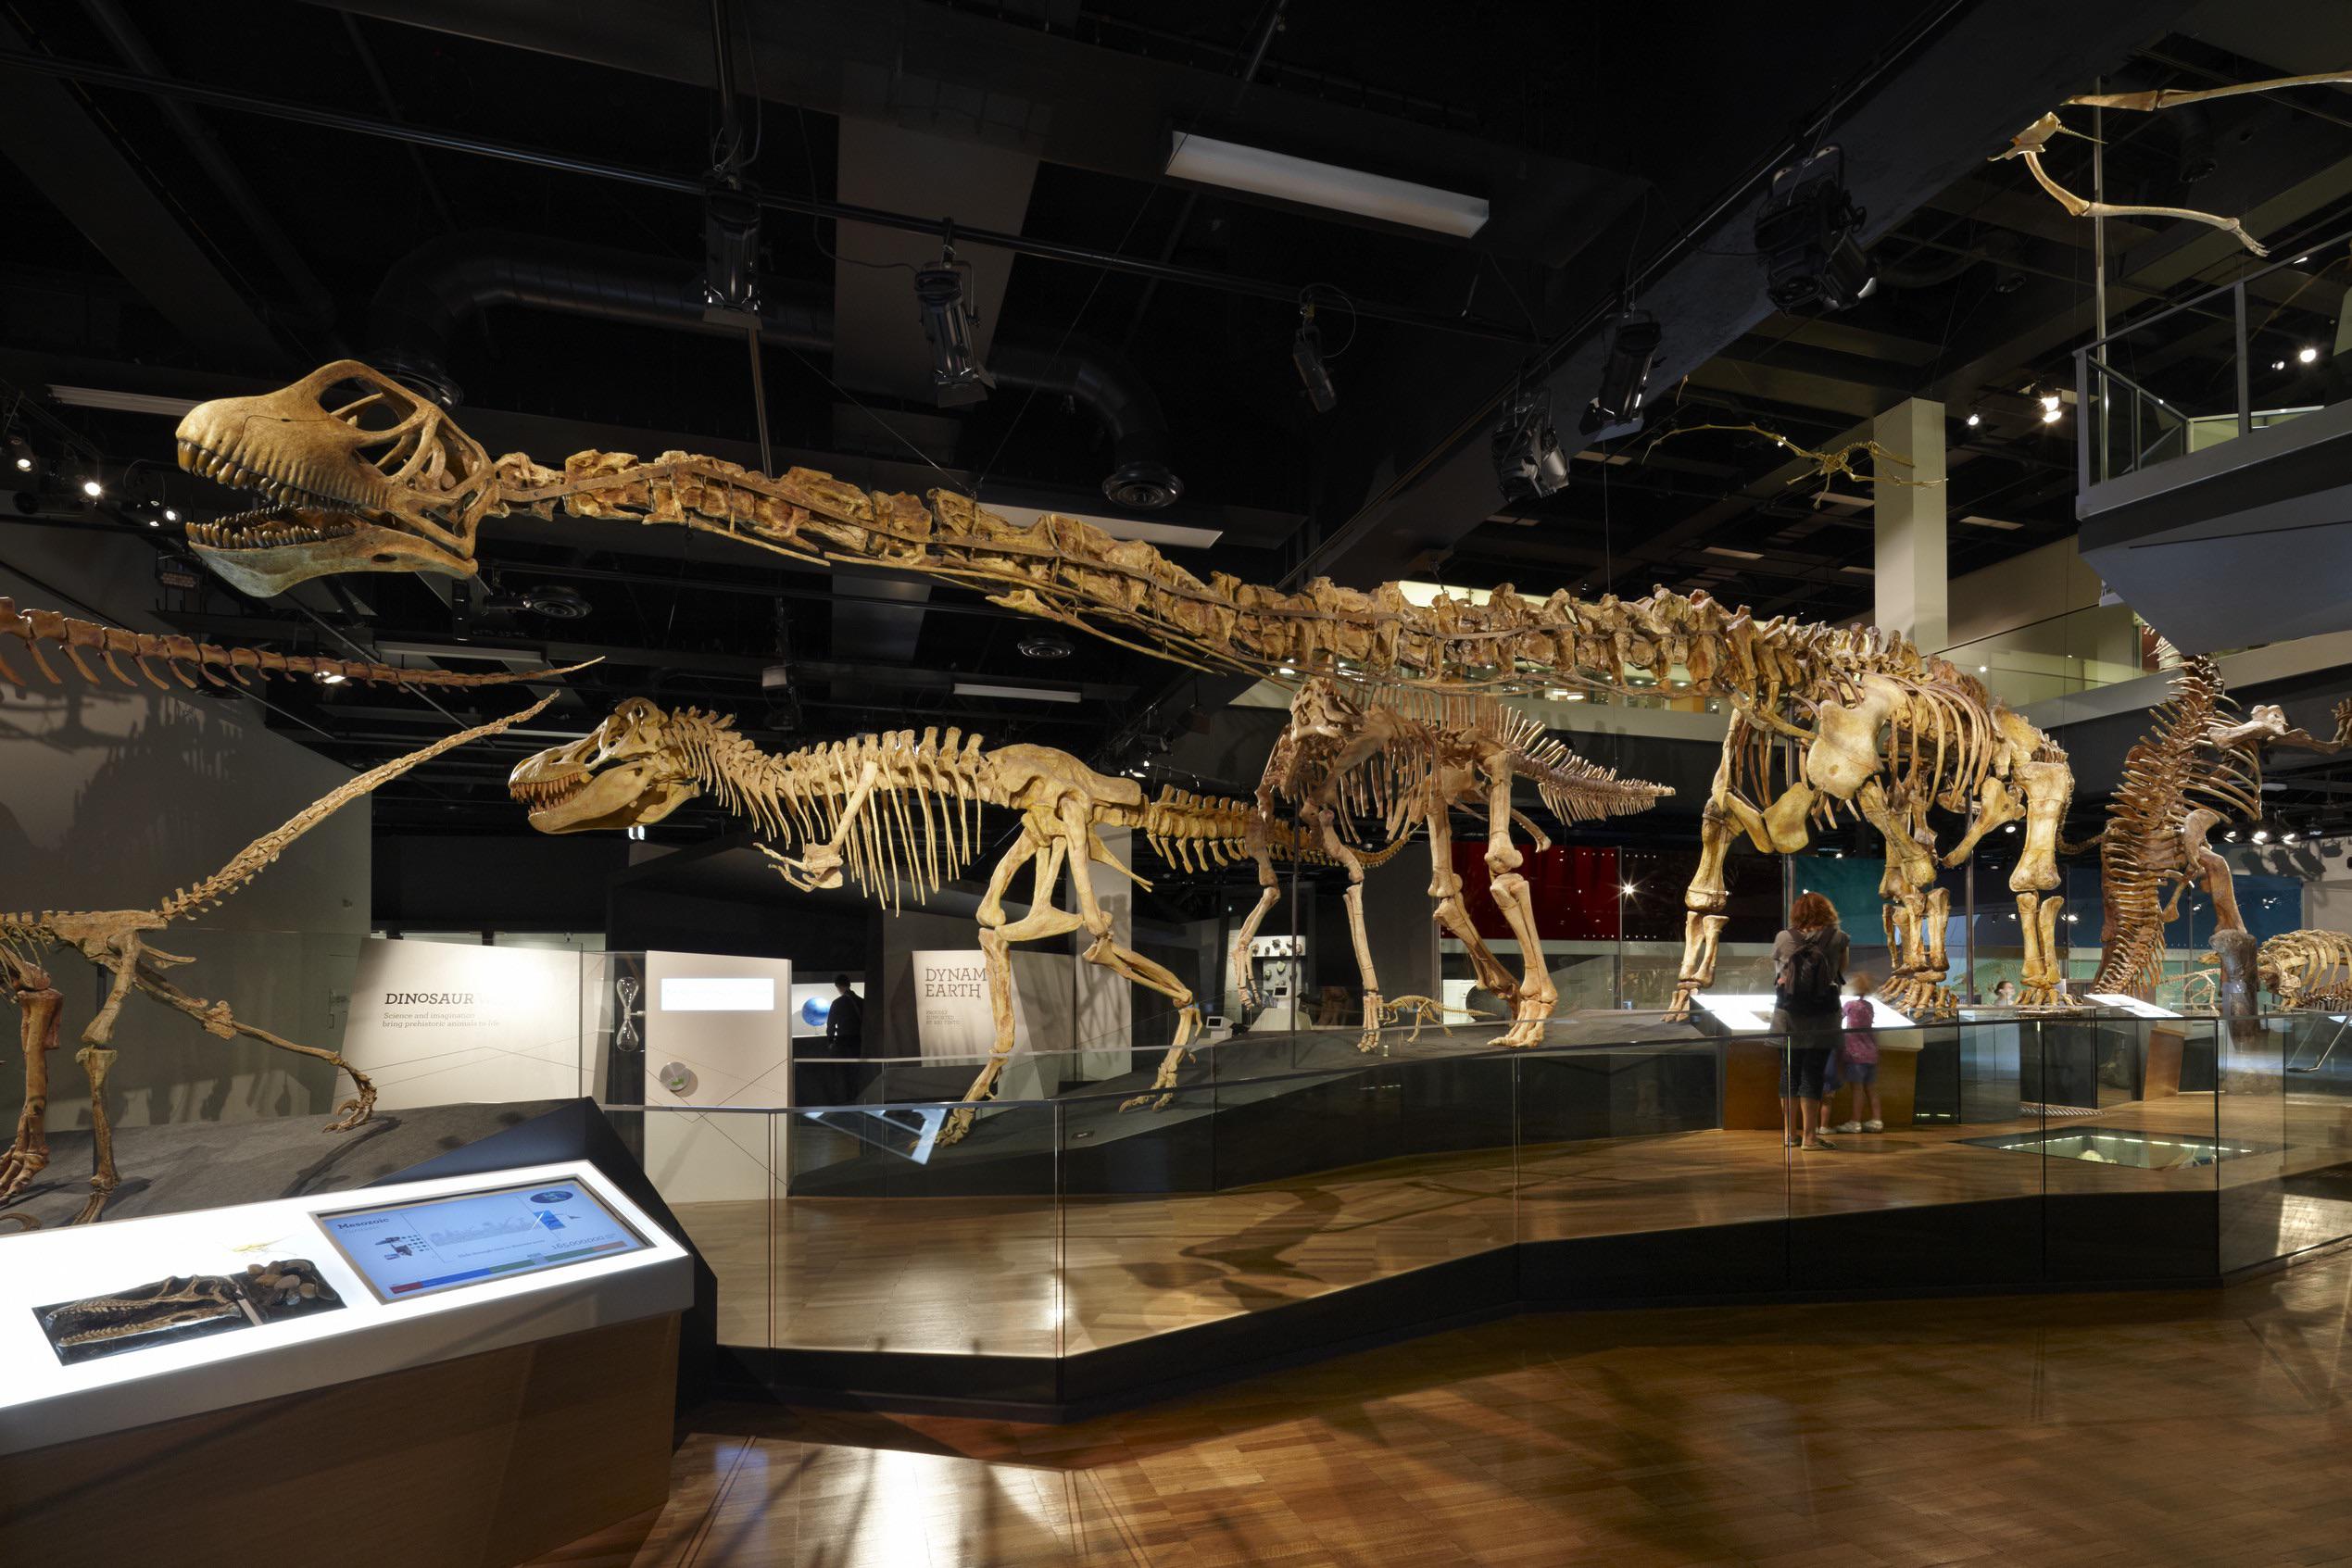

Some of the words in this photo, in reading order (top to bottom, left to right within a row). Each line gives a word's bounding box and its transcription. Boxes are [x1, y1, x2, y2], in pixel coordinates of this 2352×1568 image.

[925, 968, 987, 982] DYNAM
[925, 984, 981, 997] EARTH
[384, 993, 474, 1005] DINOSAUR
[384, 1011, 413, 1020] Science
[414, 1011, 429, 1020] and
[431, 1011, 475, 1022] imagination
[382, 1020, 403, 1028] bring
[404, 1020, 446, 1028] prehistoric
[337, 1217, 389, 1230] Mesozoic
